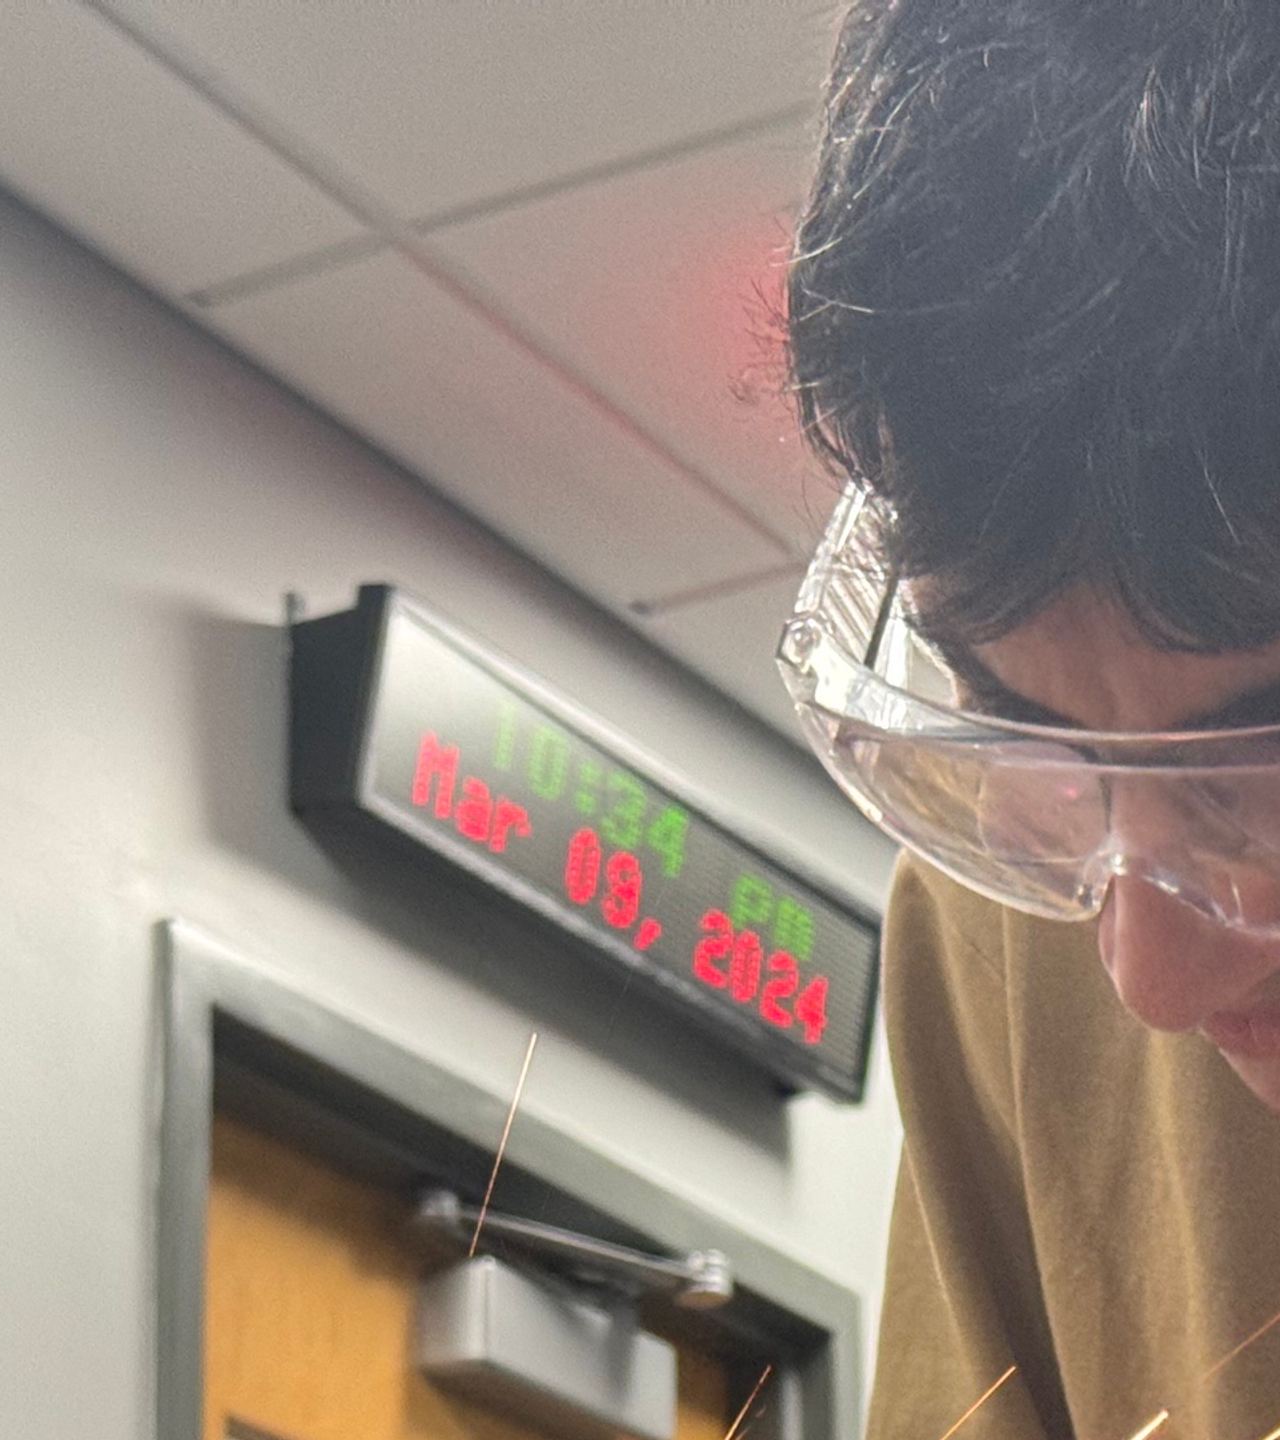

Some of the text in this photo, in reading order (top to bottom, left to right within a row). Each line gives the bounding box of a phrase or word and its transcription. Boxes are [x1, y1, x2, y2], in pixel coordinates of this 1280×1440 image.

[411, 728, 532, 853] Mar
[693, 908, 829, 1045] 2024
[494, 698, 689, 880] 10:34
